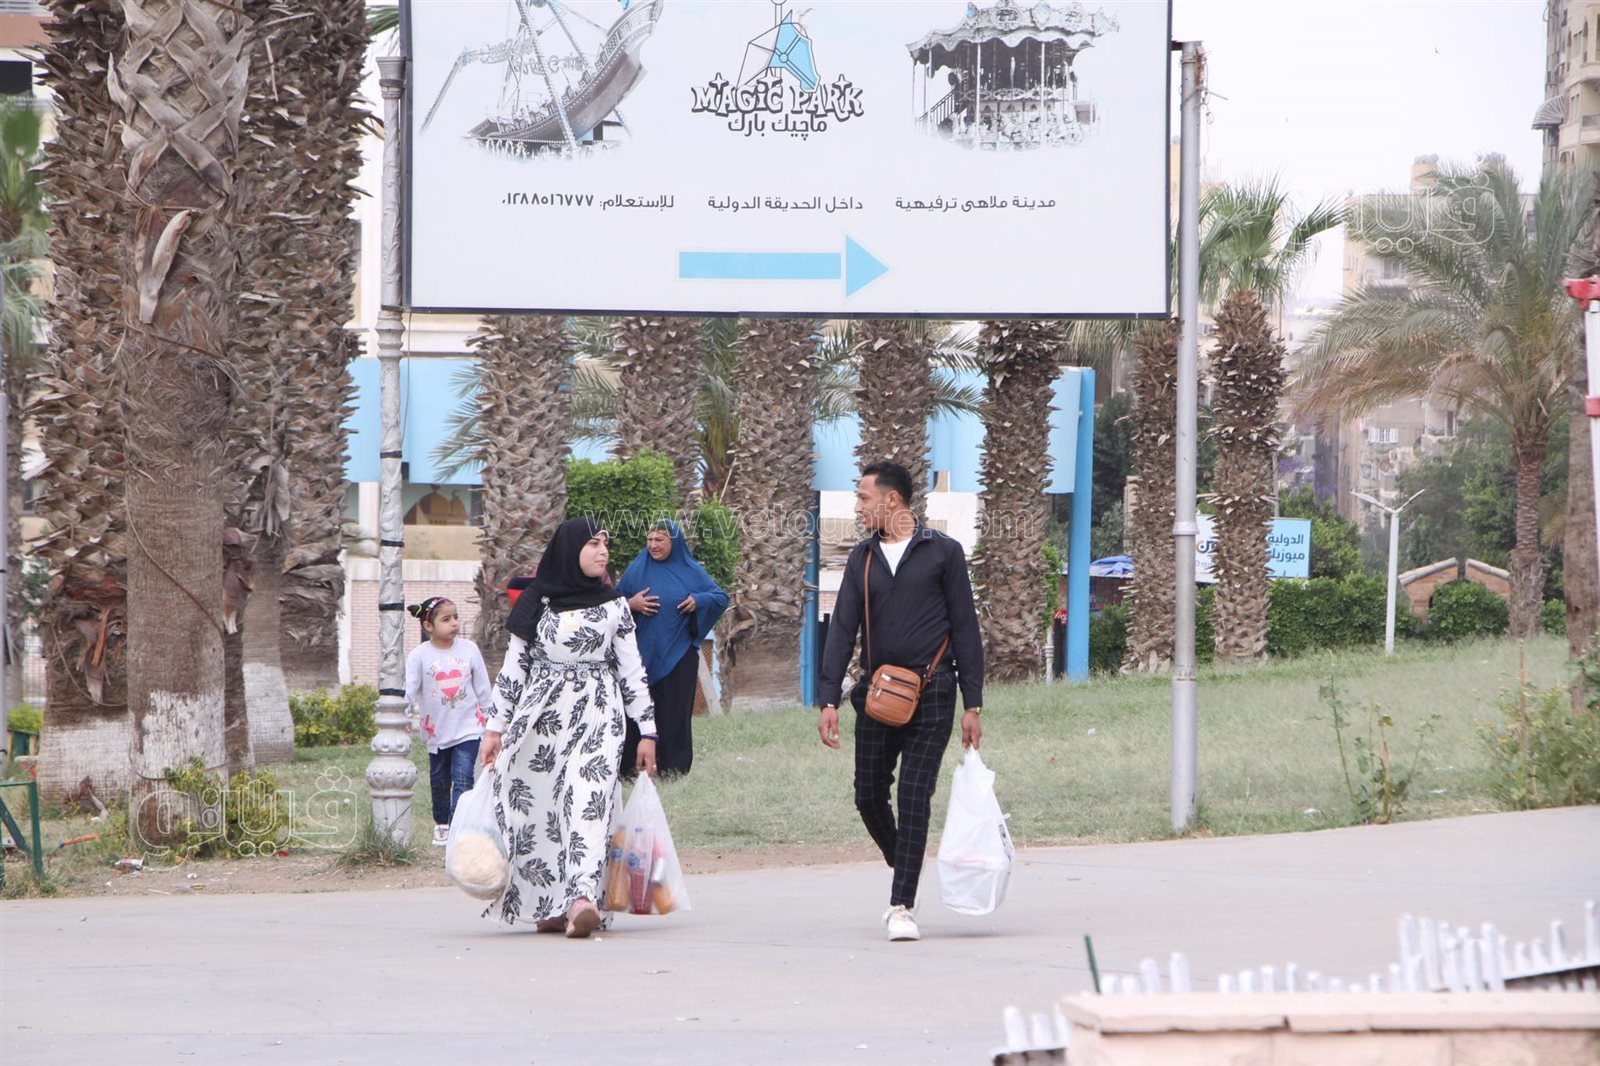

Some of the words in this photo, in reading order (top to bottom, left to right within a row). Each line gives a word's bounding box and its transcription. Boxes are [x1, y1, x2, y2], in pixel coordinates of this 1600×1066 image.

[790, 74, 864, 122] PARK
[728, 114, 765, 137] بارك
[600, 194, 674, 211] للإستعلام:
[708, 196, 760, 212] الدولية
[764, 197, 821, 212] الحديقة
[825, 197, 863, 213] داخل
[895, 195, 957, 212] ترفيهية
[961, 196, 1008, 212] ملاهى
[1012, 196, 1056, 210] مدينة
